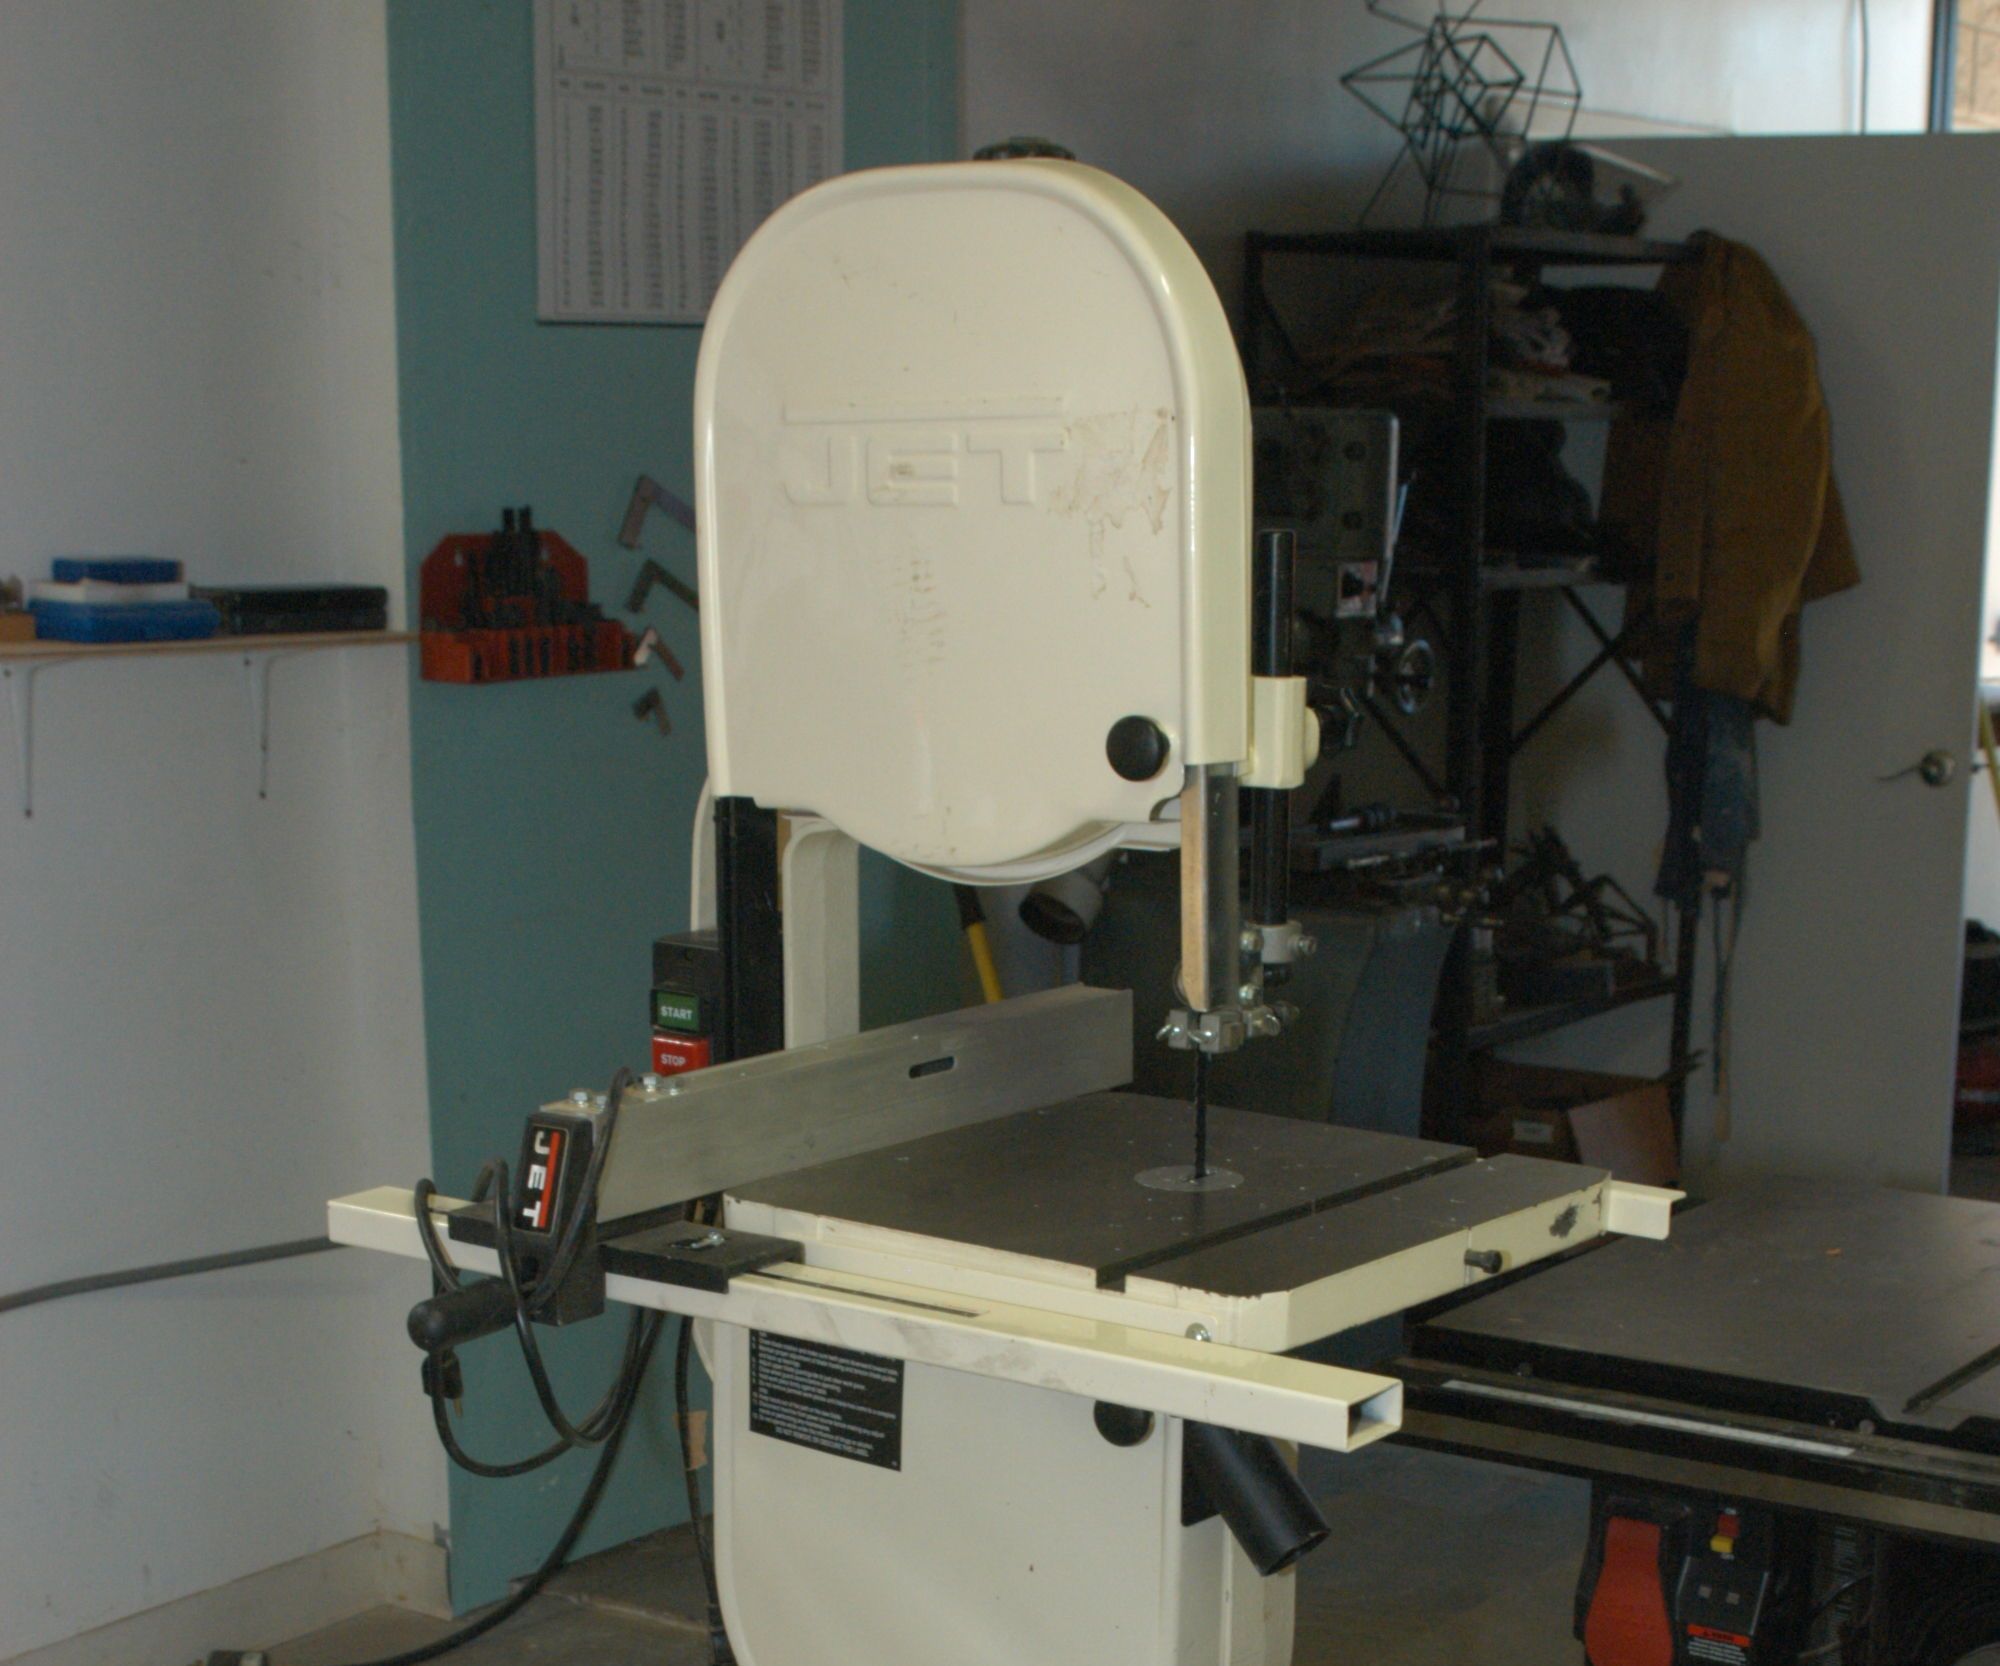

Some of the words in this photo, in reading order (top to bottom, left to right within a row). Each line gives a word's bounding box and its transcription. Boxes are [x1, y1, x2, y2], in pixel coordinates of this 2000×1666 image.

[783, 428, 1068, 507] JET
[661, 1006, 693, 1020] START
[661, 1053, 686, 1066] STOP
[523, 1130, 550, 1227] JET
